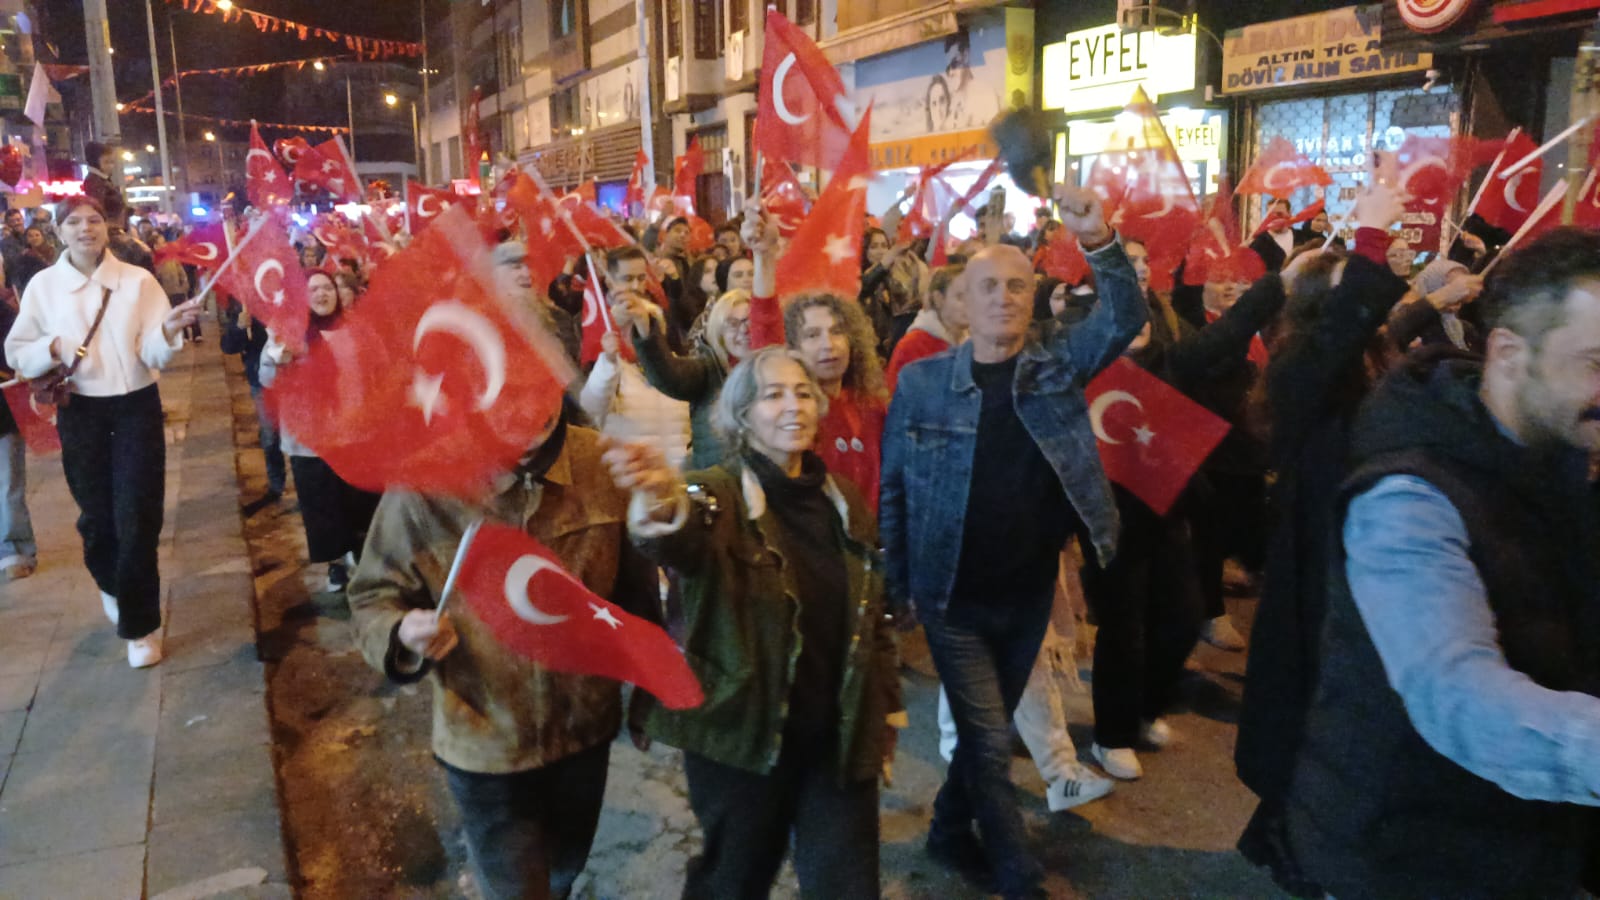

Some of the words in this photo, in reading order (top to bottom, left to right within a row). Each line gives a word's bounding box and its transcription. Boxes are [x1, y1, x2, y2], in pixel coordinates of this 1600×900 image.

[1070, 32, 1148, 80] EYFEL
[1227, 65, 1288, 89] DÖVİZ
[1293, 60, 1340, 79] ALIN
[1349, 51, 1418, 74] SATIN
[1257, 49, 1315, 67] ALTIN
[1177, 127, 1217, 147] EYFEL
